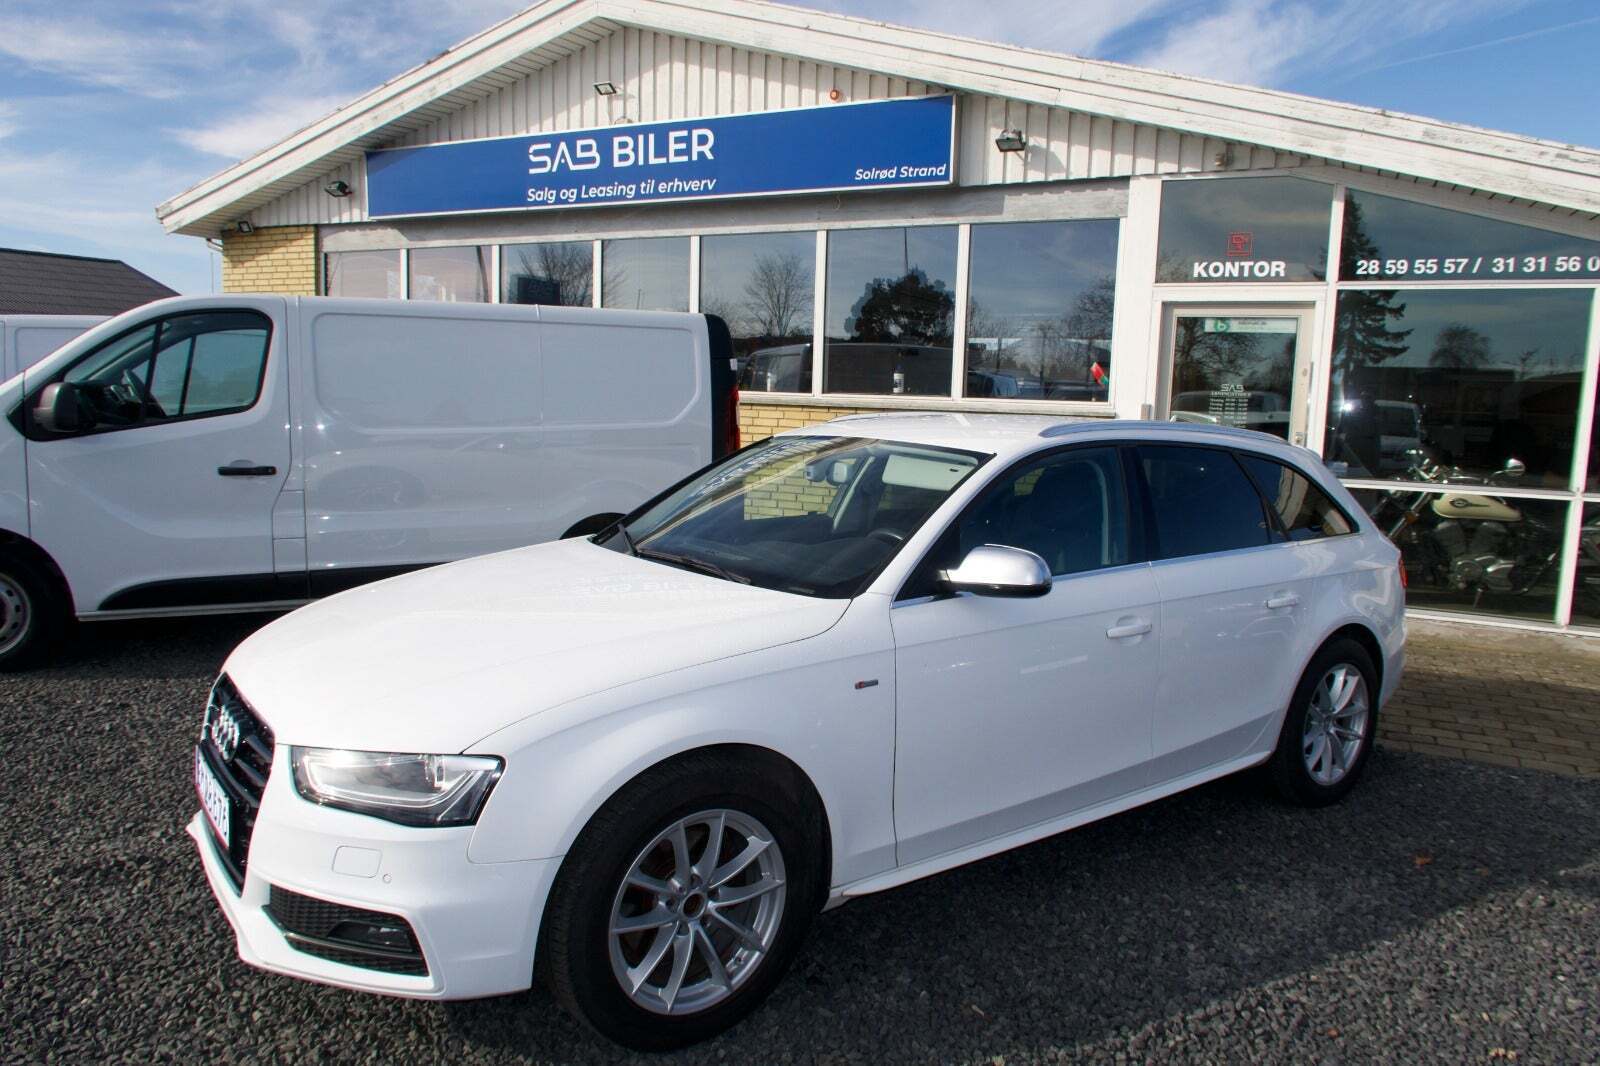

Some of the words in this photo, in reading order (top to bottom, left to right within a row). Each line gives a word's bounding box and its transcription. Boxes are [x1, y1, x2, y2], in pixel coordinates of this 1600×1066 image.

[528, 138, 600, 175] SAB
[612, 127, 715, 169] BILER
[855, 166, 897, 181] Solrød
[900, 163, 947, 178] Strand
[527, 186, 557, 204] Salg
[559, 188, 578, 202] og
[581, 182, 636, 199] Leasing
[640, 179, 655, 195] til
[658, 177, 717, 194] erhverv
[1193, 260, 1287, 278] KONTOR
[1356, 259, 1380, 275] 28
[1384, 259, 1409, 275] 59
[1413, 258, 1438, 274] 55
[1491, 256, 1516, 273] 31
[1522, 256, 1547, 273] 31
[1554, 255, 1581, 272] 56
